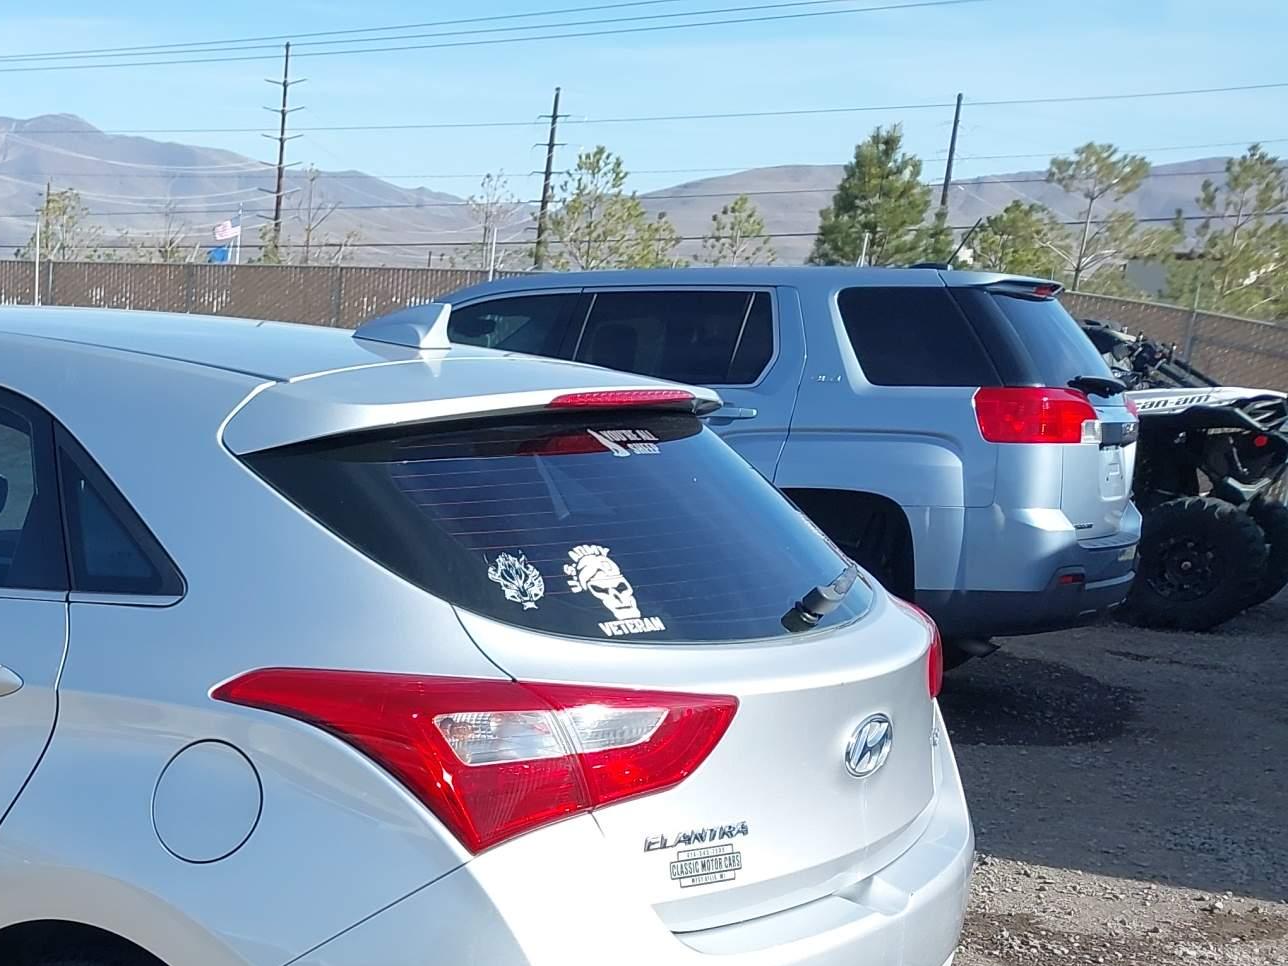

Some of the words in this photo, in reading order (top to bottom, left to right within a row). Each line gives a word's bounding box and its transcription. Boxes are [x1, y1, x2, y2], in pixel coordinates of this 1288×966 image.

[568, 544, 610, 562] ARMY
[598, 616, 666, 637] VETERAN
[643, 820, 749, 853] ELANTRA
[671, 860, 700, 878] CLASSIC
[700, 857, 723, 873] MOTOR
[723, 854, 740, 869] CARS
